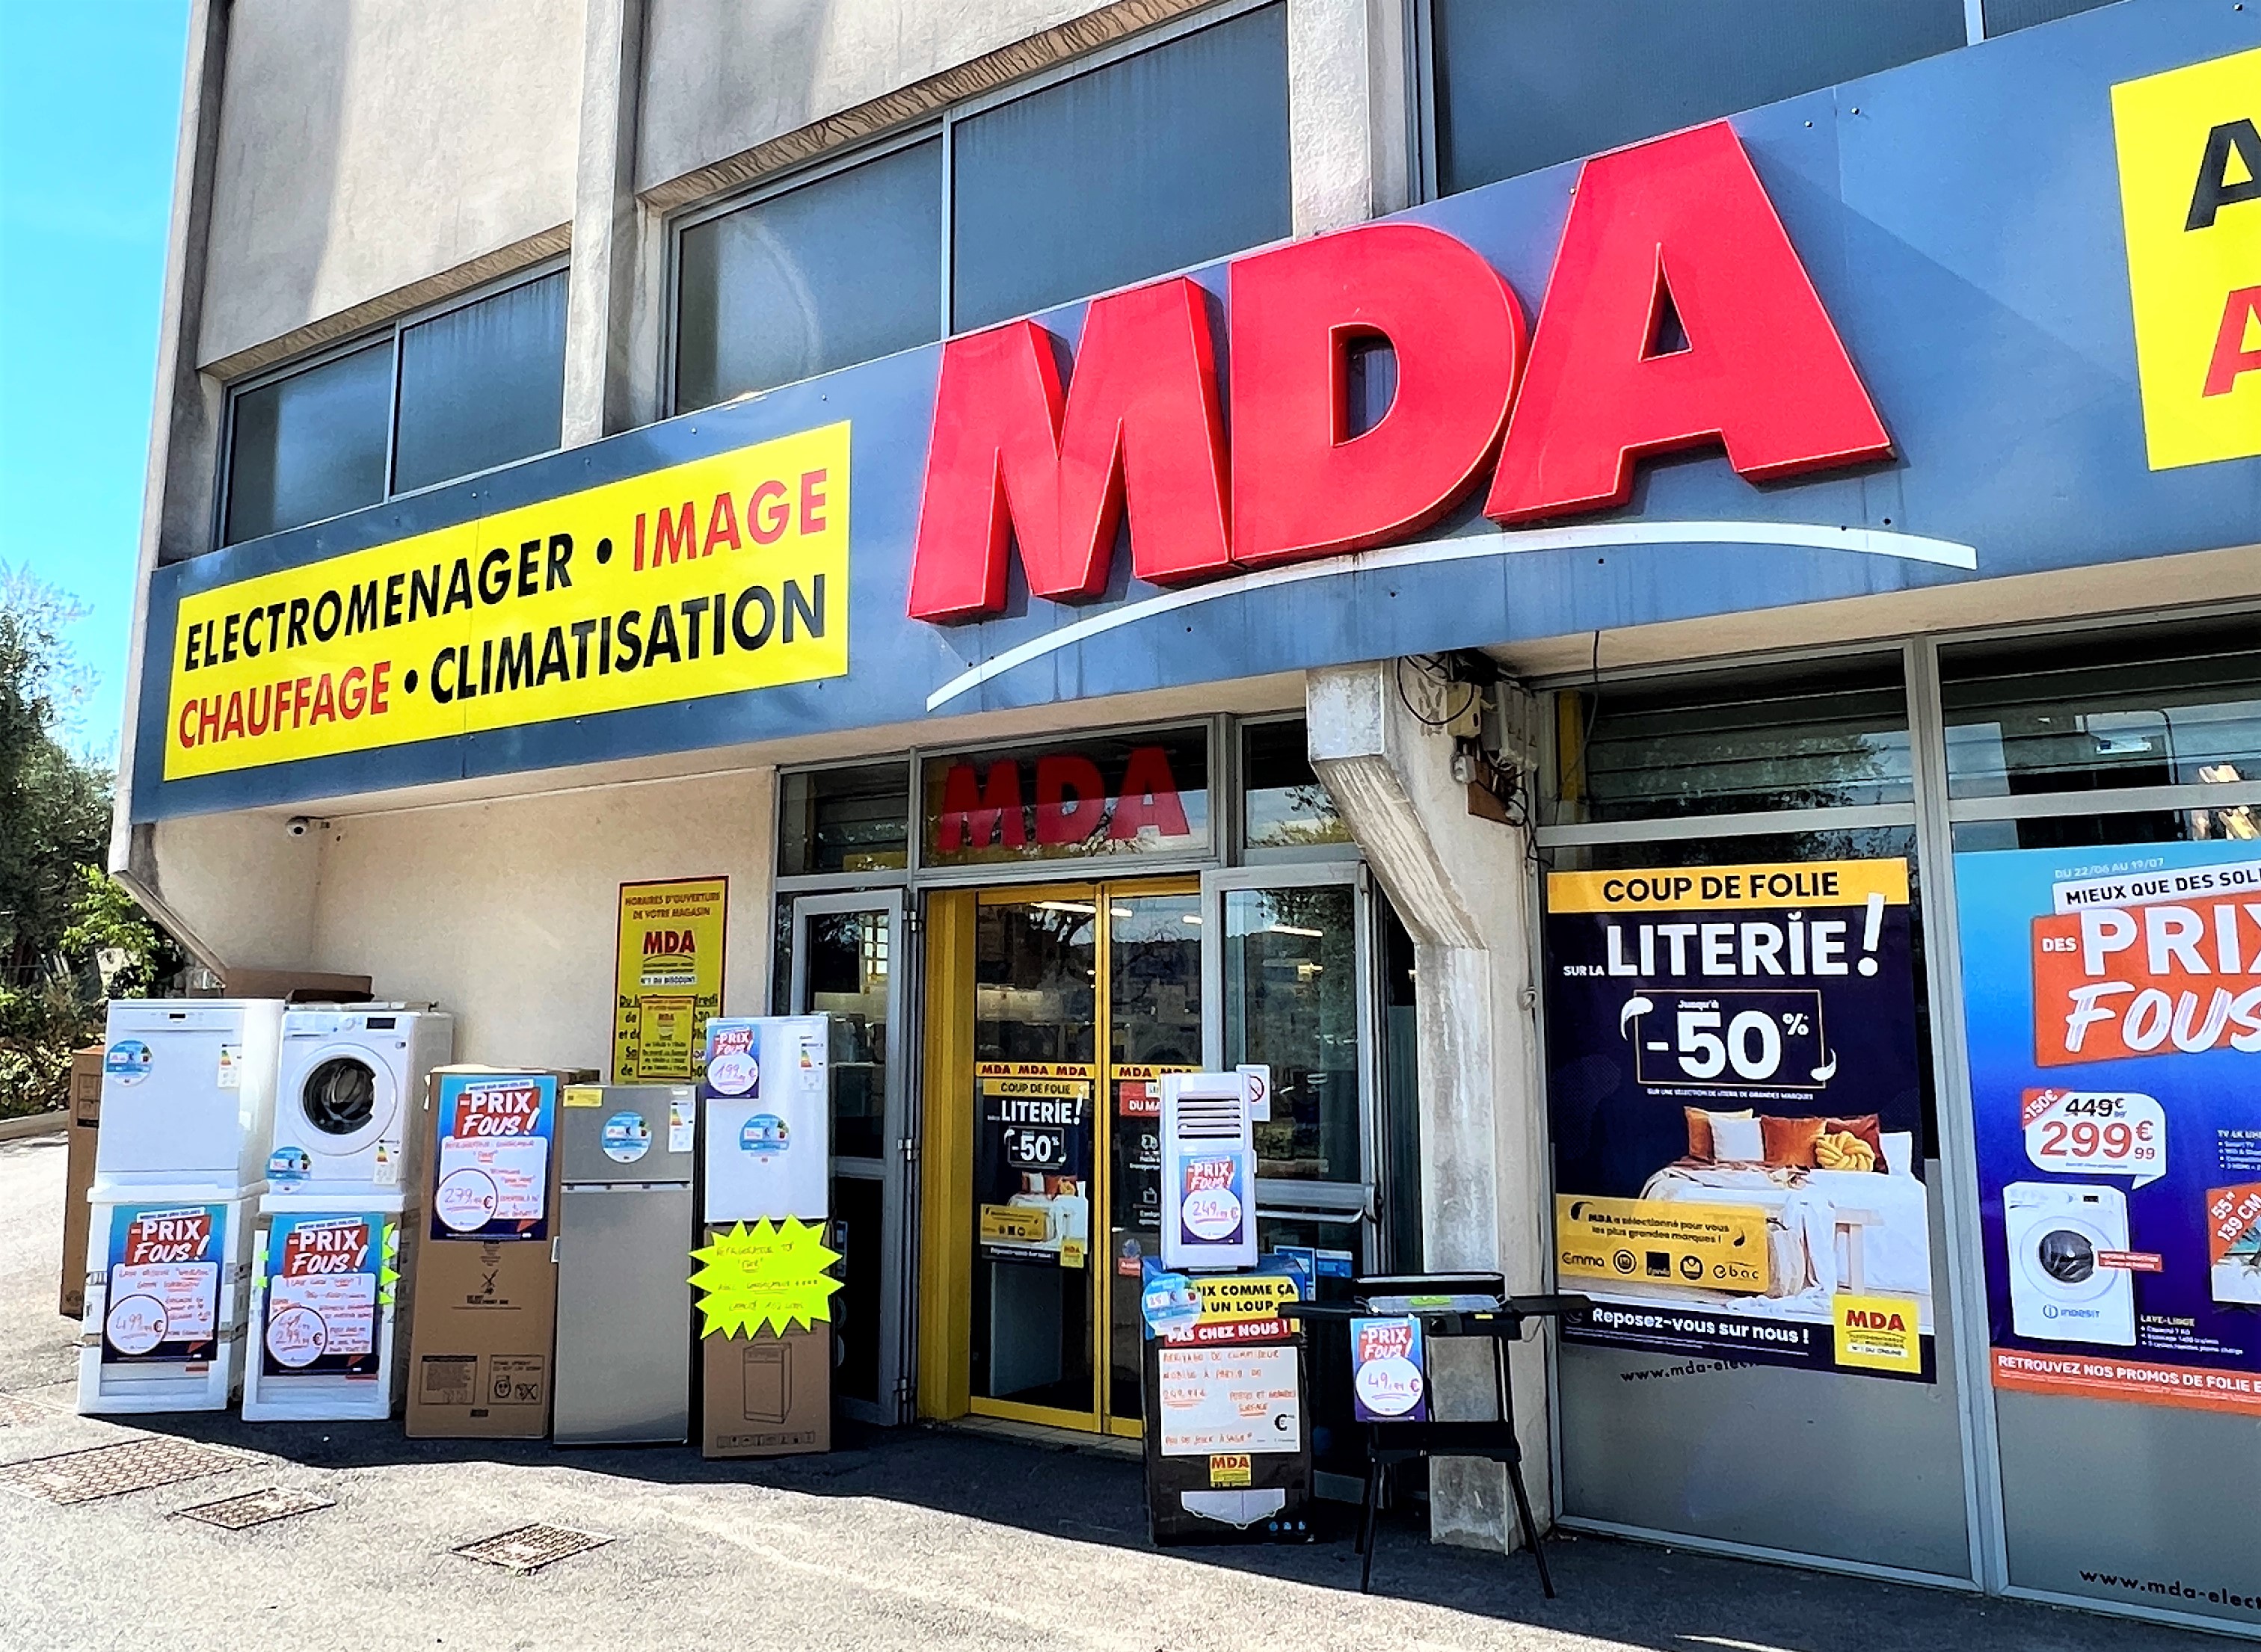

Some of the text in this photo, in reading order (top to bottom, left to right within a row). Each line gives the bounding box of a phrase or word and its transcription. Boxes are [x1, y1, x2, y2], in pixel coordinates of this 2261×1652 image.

[907, 118, 1897, 625] MDA
[184, 468, 828, 671] ELECTROMENAGER IMAGE
[179, 573, 825, 749] CHAUFFAGE CLIMATISATION
[938, 745, 1190, 853] MDA
[2055, 868, 2070, 879] DU
[2073, 863, 2110, 878] 22/06
[2111, 861, 2129, 873] AU
[1603, 872, 1839, 902] COUP DE FOLIE
[2066, 868, 2261, 905] MIEUX QUE DES SOL
[645, 908, 670, 919] VOTRE
[672, 907, 710, 917] MAGASIN
[643, 930, 695, 955] MDA
[2042, 937, 2077, 952] DES
[1563, 965, 1588, 976] SUR
[1590, 965, 1605, 976] LA
[719, 1032, 750, 1044] PRIX
[982, 1065, 1087, 1076] MDA MDA MDA
[1119, 1067, 1151, 1077] MDA
[1000, 1082, 1071, 1094] COUP DE FOLIE
[470, 1092, 532, 1113] PRIX
[1129, 1100, 1143, 1112] DU
[2040, 1121, 2132, 1159] 299
[1194, 1162, 1229, 1177] PRIX
[142, 1219, 202, 1241] PRIX
[1705, 1224, 1729, 1233] vous
[2218, 1216, 2243, 1241] 139
[300, 1230, 360, 1251] PRIX
[1197, 1283, 1295, 1298] IX COMME ÇA
[1211, 1301, 1231, 1313] UN
[1593, 1308, 1715, 1334] Reposez-vous
[1719, 1322, 1749, 1337] sur
[1753, 1326, 1799, 1343] nous
[1846, 1310, 1906, 1331] MDA
[1199, 1328, 1234, 1340] CHEZ
[1238, 1322, 1279, 1337] NOUS
[1368, 1328, 1407, 1343] PRIX
[1998, 1355, 2081, 1375] RETROUVEZ
[2084, 1364, 2114, 1378] NOS
[2116, 1368, 2180, 1385] PROMOS
[2182, 1375, 2203, 1387] DE
[2206, 1376, 2251, 1393] FOLIE
[1211, 1456, 1250, 1470] MDA
